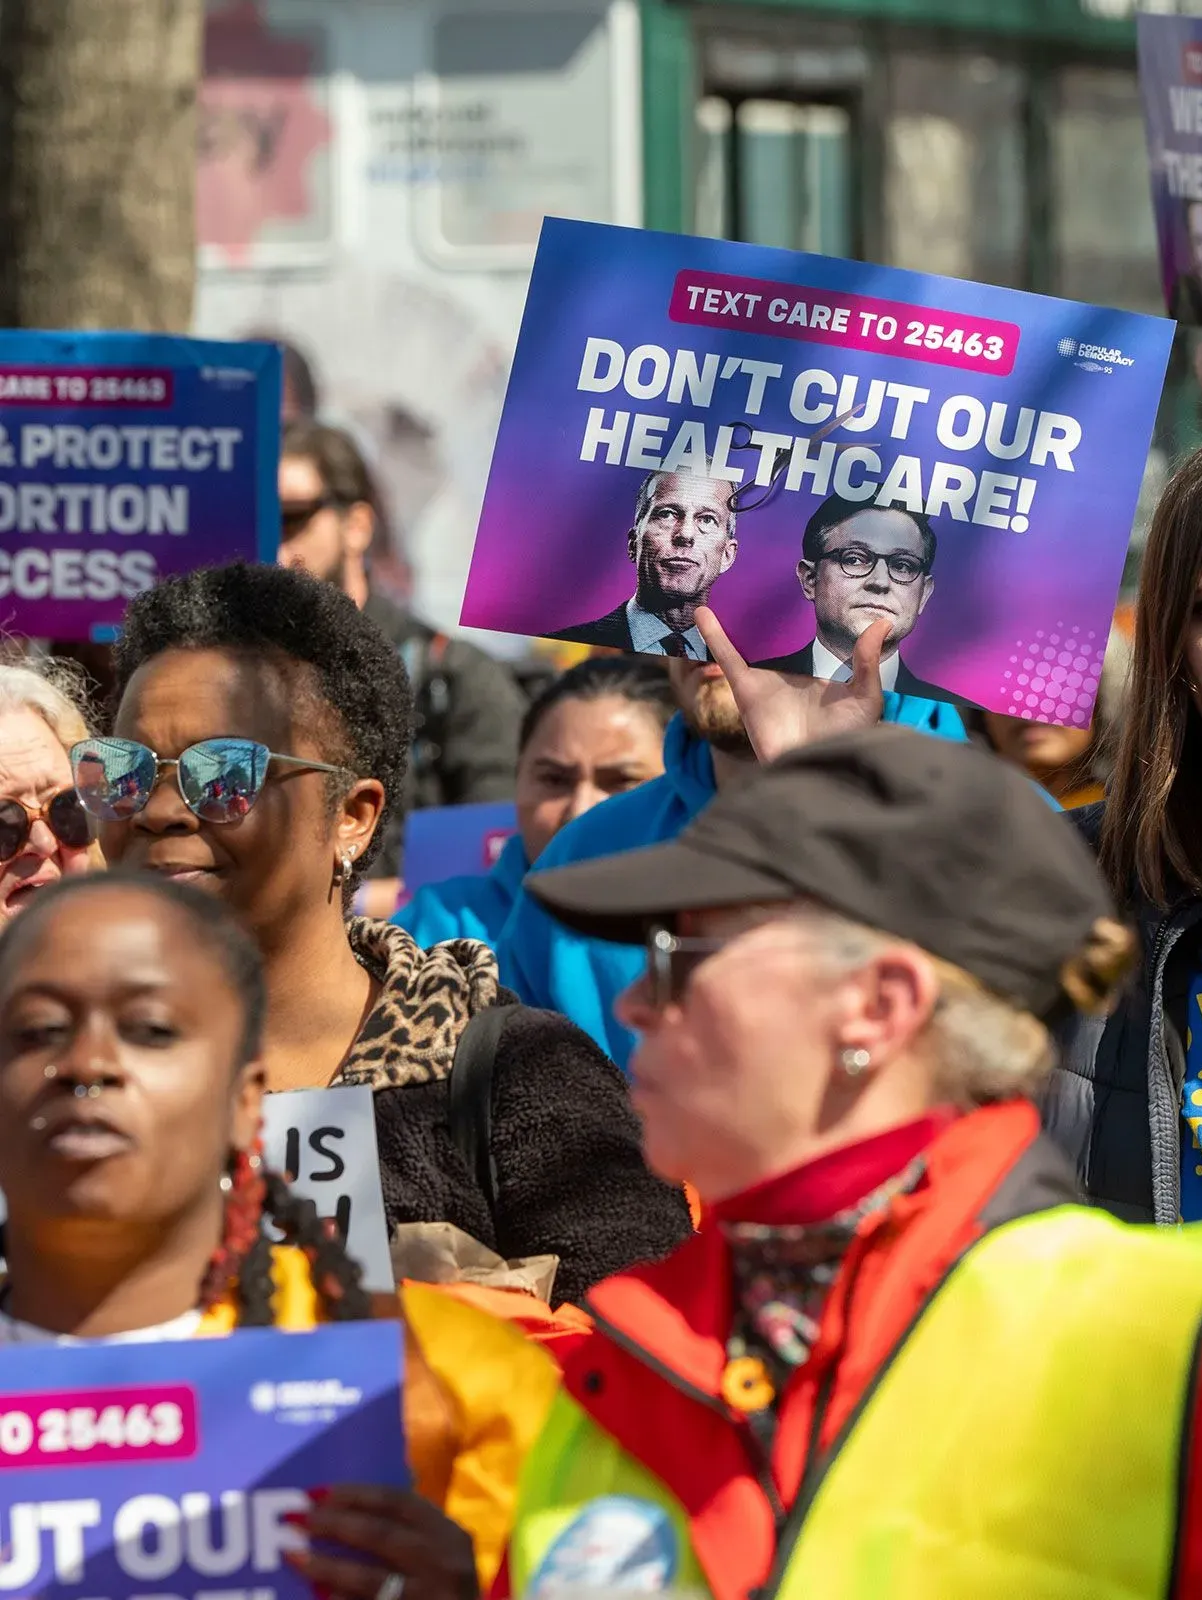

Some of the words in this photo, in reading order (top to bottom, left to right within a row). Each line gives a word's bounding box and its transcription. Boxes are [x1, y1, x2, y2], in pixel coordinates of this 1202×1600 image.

[687, 286, 762, 318] TEXT
[768, 298, 851, 333] CARE
[859, 311, 898, 341] TO
[904, 321, 1005, 361] 25463
[1078, 350, 1134, 366] DEMOCRACY
[1080, 343, 1121, 357] POPULAR
[1104, 366, 1113, 374] 95
[0, 376, 51, 400] ARE
[54, 376, 87, 400] TO
[577, 337, 783, 415] DON'T
[789, 369, 930, 440] CUT
[936, 394, 1082, 473] OUR
[21, 424, 243, 471] PROTECT
[580, 407, 1037, 533] HEALTHCARE!
[0, 547, 157, 600] CESS
[286, 1126, 345, 1182] IS
[37, 1401, 184, 1453] 25463
